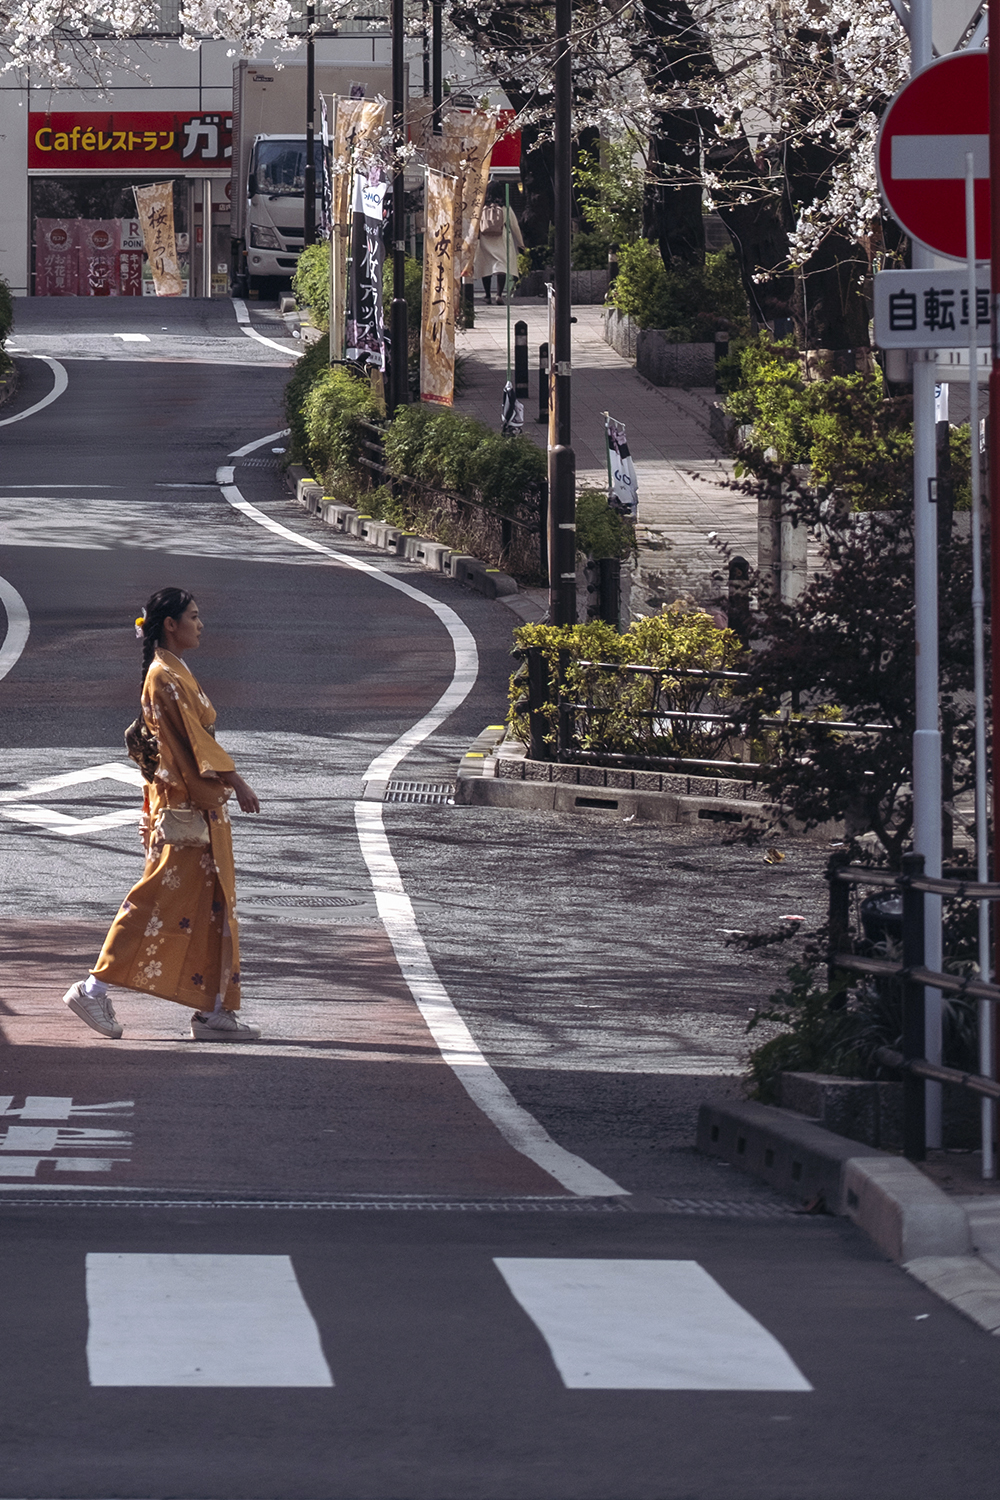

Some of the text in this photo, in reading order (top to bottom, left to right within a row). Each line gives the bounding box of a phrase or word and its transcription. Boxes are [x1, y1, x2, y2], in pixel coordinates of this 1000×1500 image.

[128, 222, 140, 236] R
[147, 206, 168, 277] 桜まつり
[44, 254, 55, 288] ガスト
[54, 254, 66, 288] お花見
[889, 287, 991, 332] 自転車
